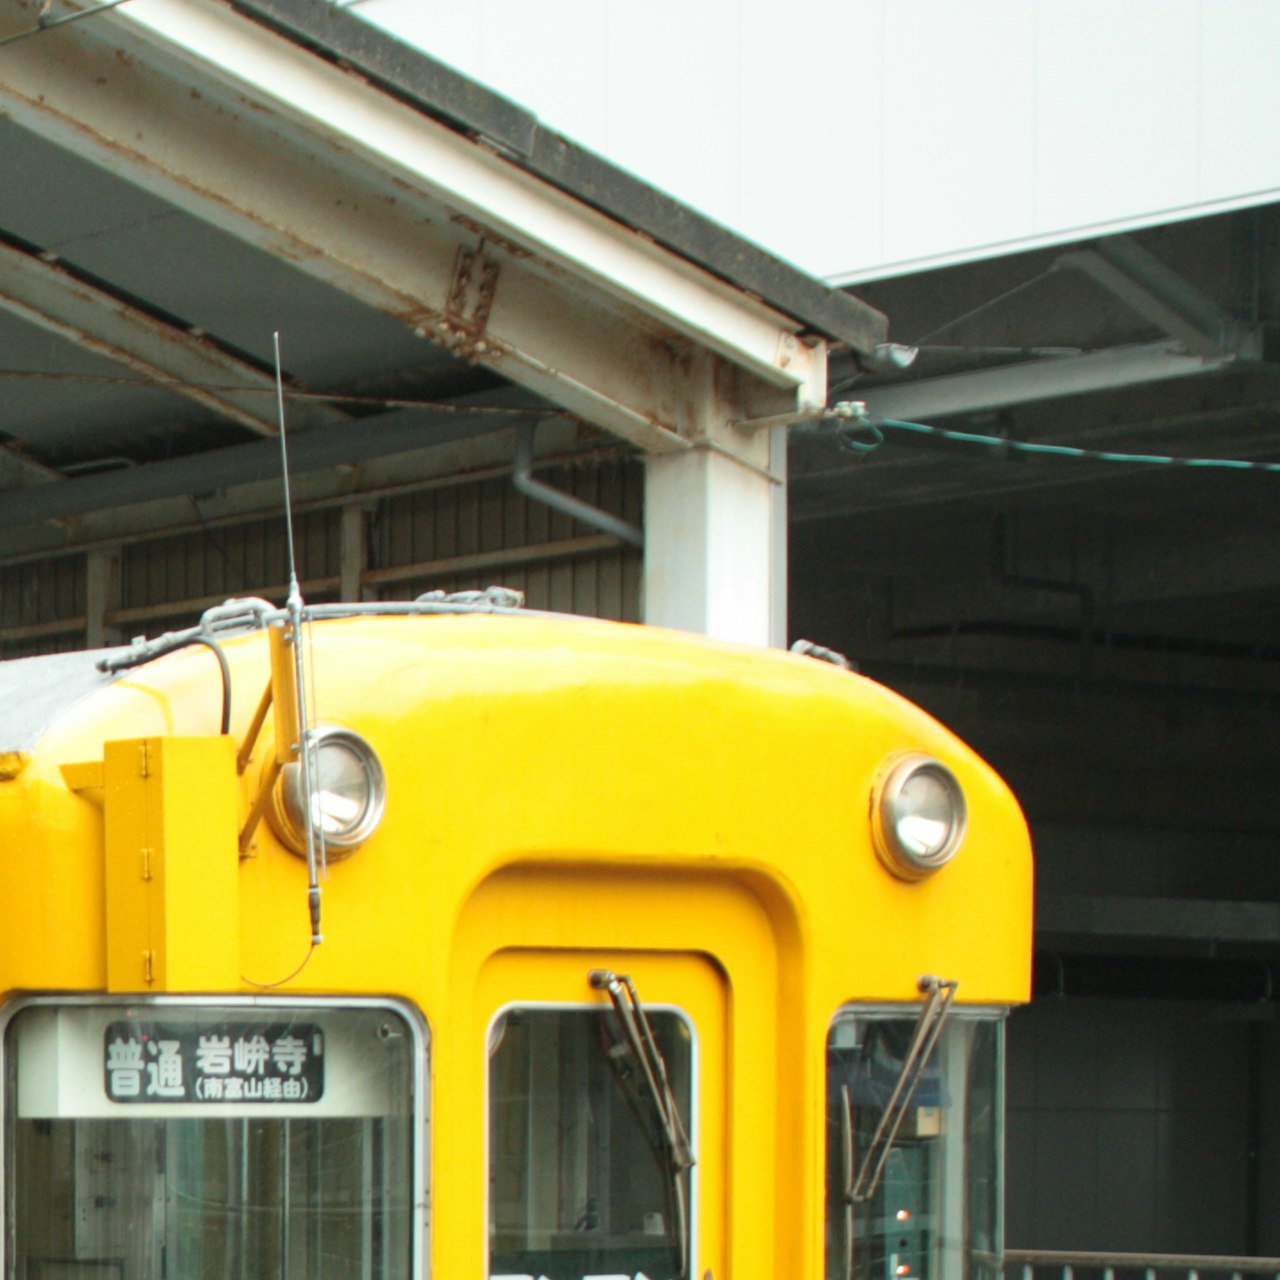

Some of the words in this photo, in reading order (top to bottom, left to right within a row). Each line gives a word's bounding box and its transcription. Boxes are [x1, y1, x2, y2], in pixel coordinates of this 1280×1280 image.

[107, 1037, 186, 1097] 普通
[195, 1034, 308, 1075] 岩峅寺
[195, 1076, 309, 1099] (南富山経由)
